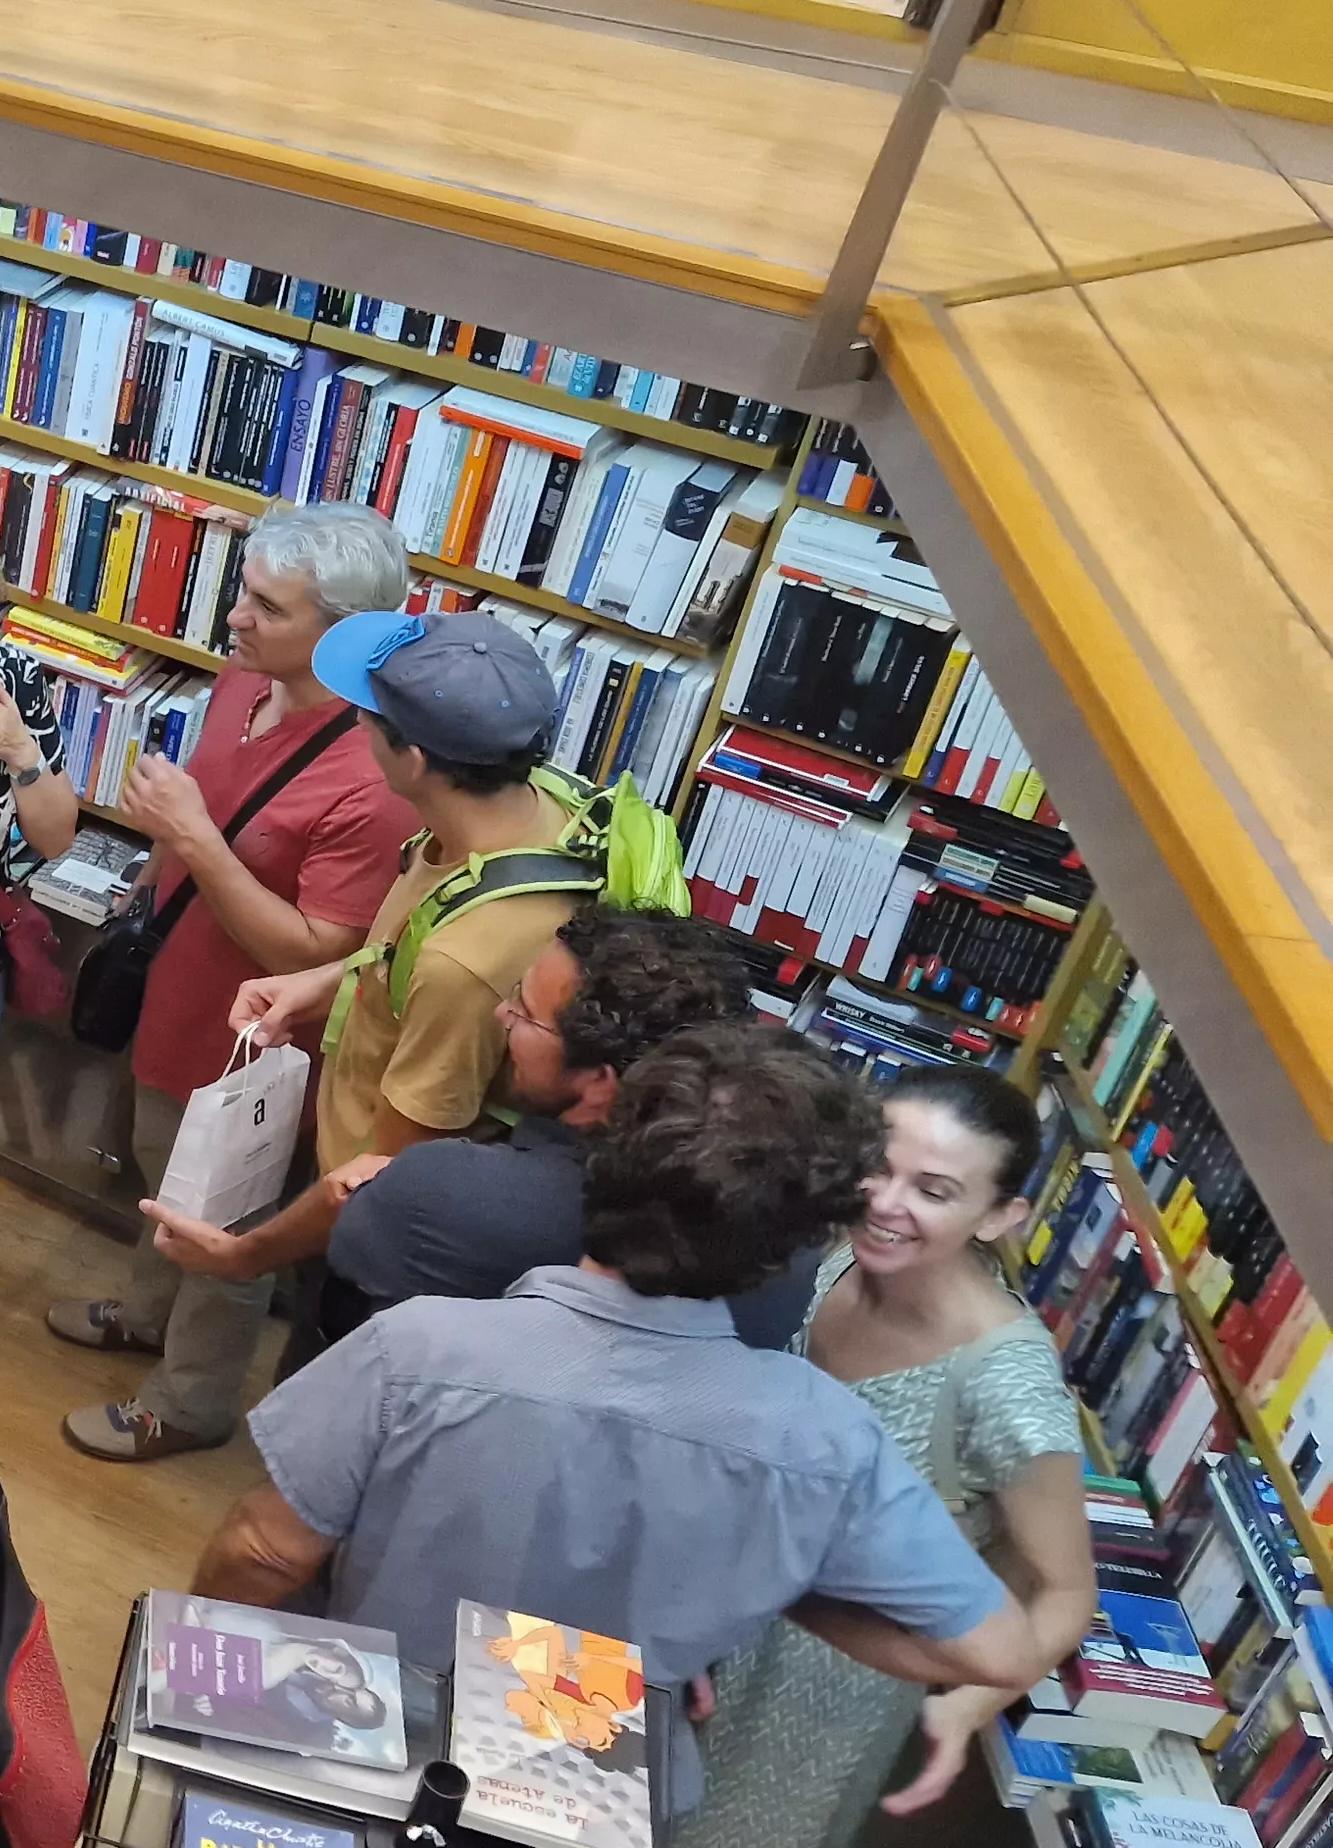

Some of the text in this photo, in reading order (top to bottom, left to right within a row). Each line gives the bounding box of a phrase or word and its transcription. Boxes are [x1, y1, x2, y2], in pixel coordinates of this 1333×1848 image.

[289, 398, 312, 452] ENSAYO
[253, 1098, 266, 1127] a
[475, 1789, 558, 1818] escuela
[477, 1774, 578, 1810] de Atenas
[1129, 1822, 1149, 1836] LA
[1132, 1810, 1231, 1837] LAS COSAS DE
